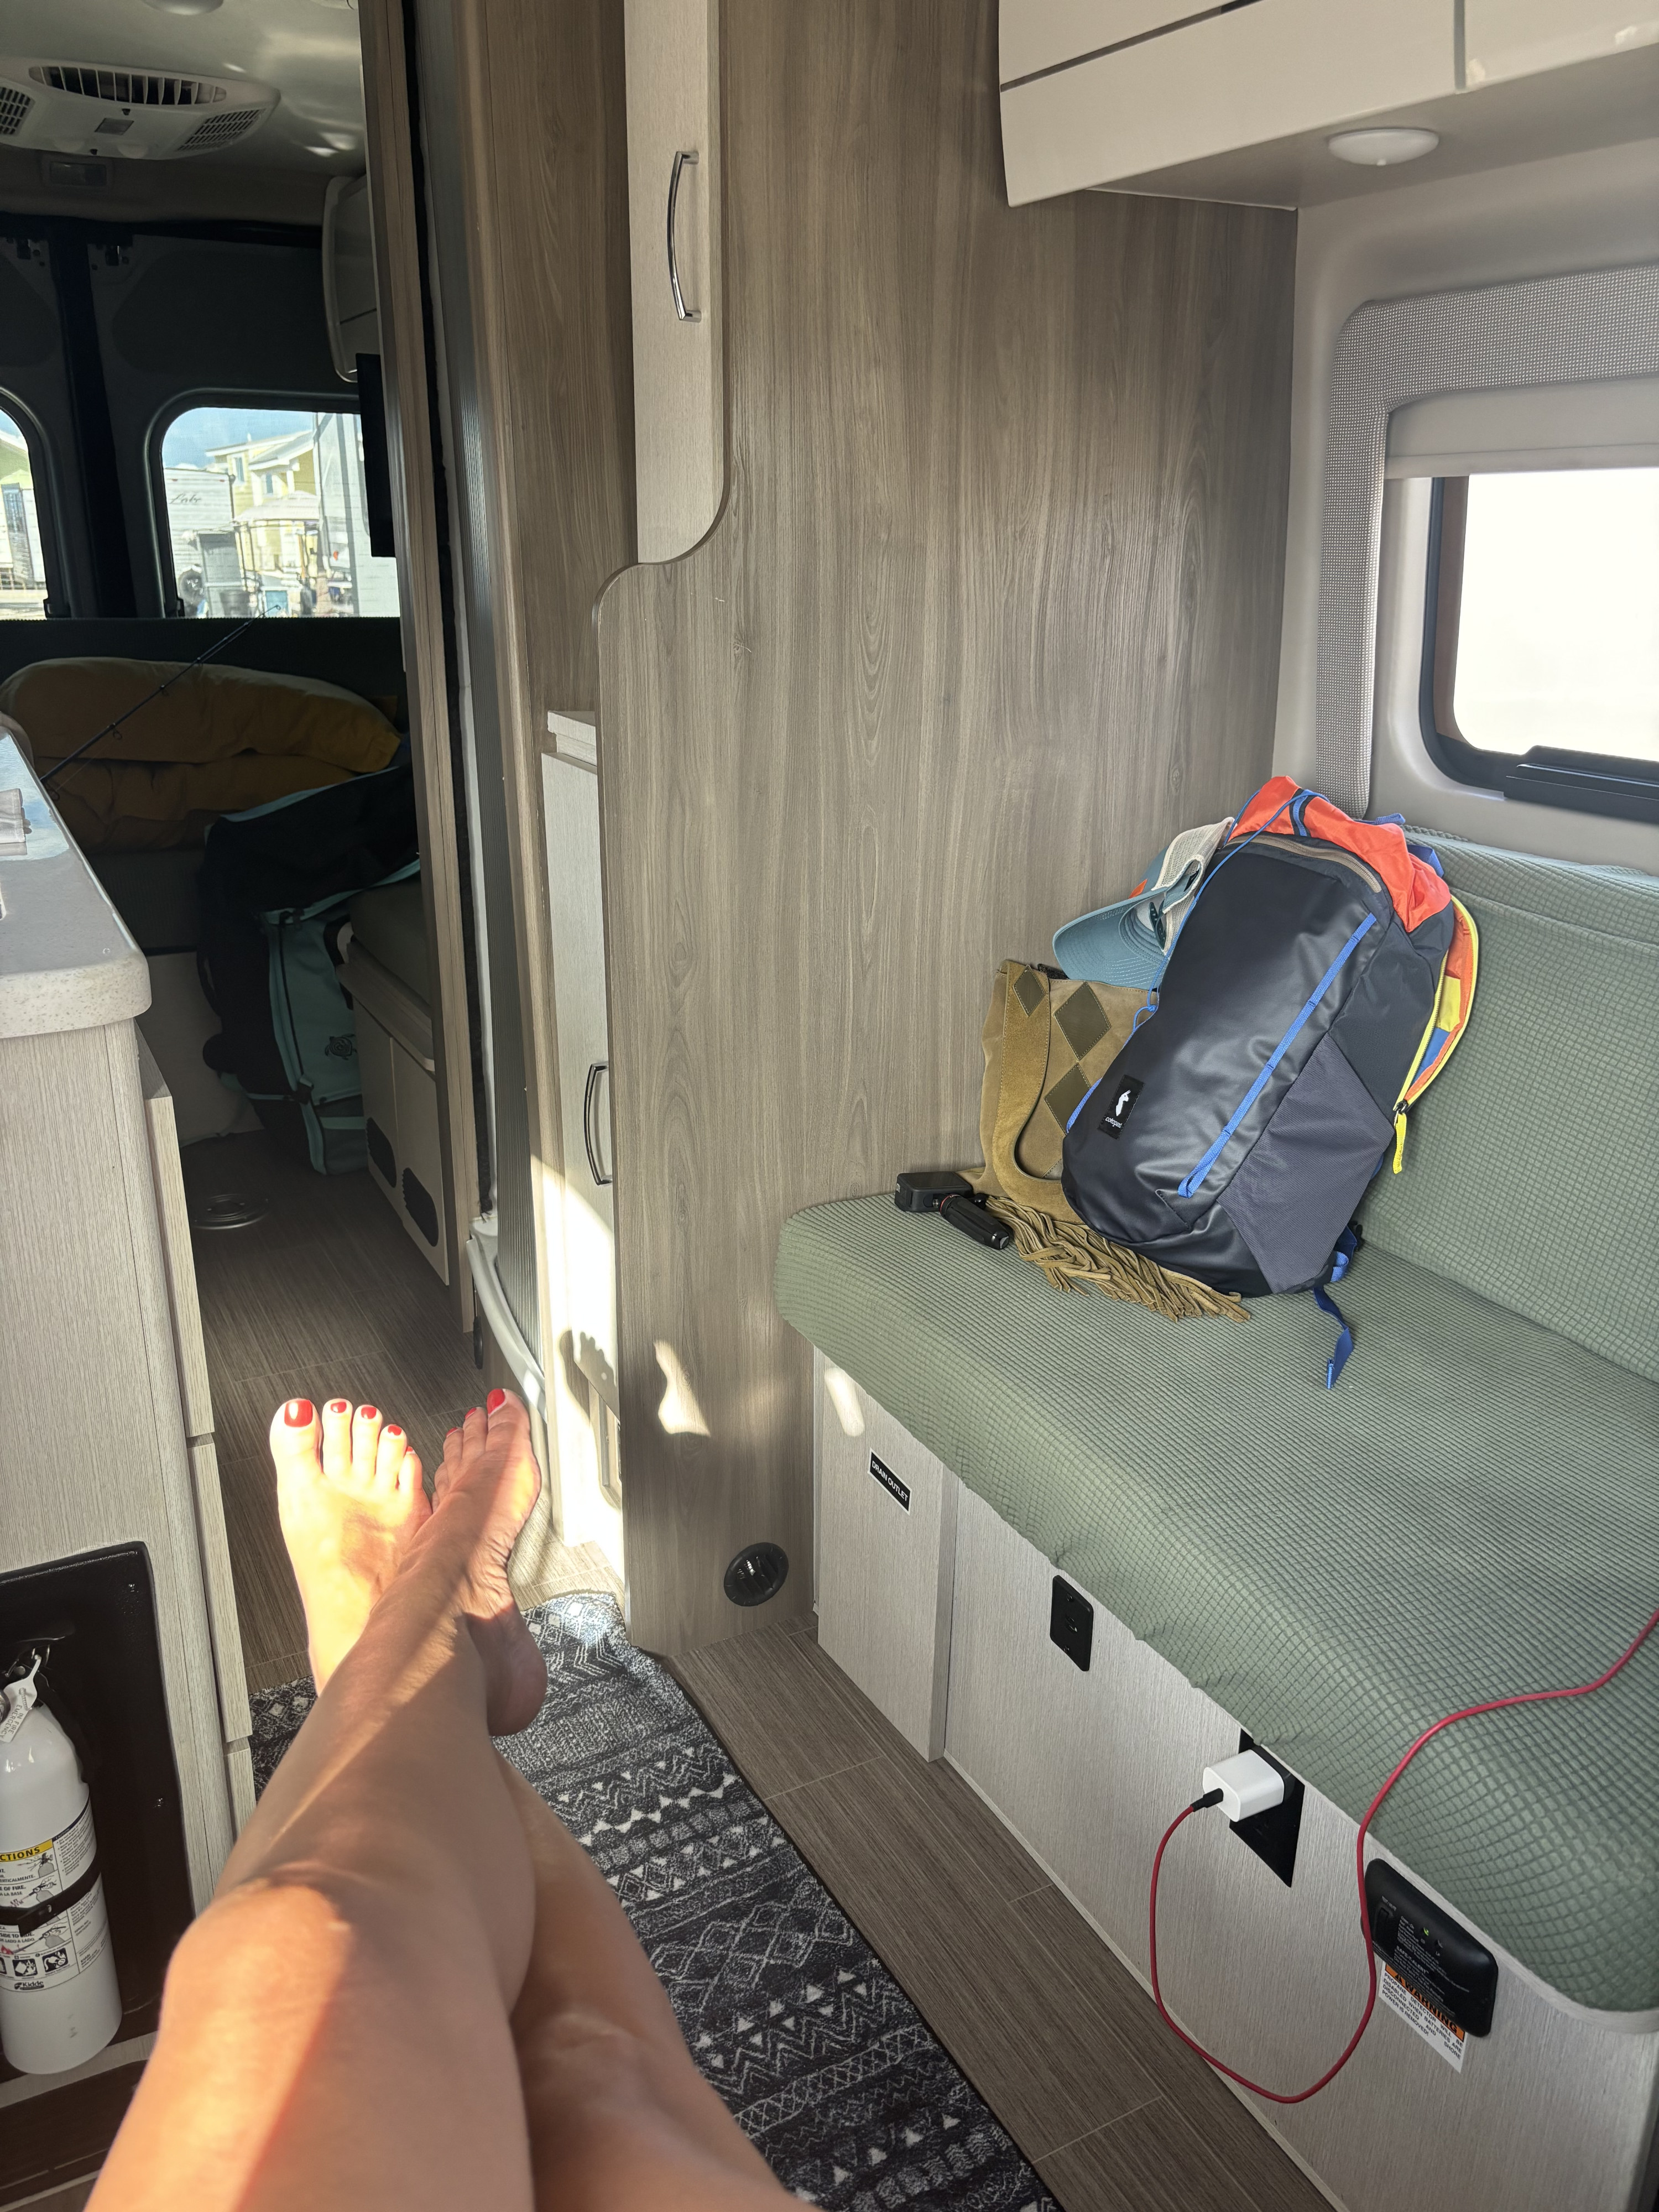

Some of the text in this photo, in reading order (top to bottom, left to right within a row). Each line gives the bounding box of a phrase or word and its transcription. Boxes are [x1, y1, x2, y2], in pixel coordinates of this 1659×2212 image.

[872, 1460, 908, 1501] DRAIN OUTLET
[0, 1704, 22, 1739] EMERGENCY
[8, 1721, 19, 1734] FIRE
[1383, 1990, 1399, 2008] POWER
[1405, 2011, 1429, 2036] REMOVED!
[1383, 1984, 1460, 2060] DISCONNECTED AND SHORE
[1384, 1973, 1463, 2048] PROPANE DETECTOR WILL BE
[1384, 1978, 1462, 2054] DISABLED WHEN BATTERIES ARE
[1405, 1981, 1457, 2034] WARNING
